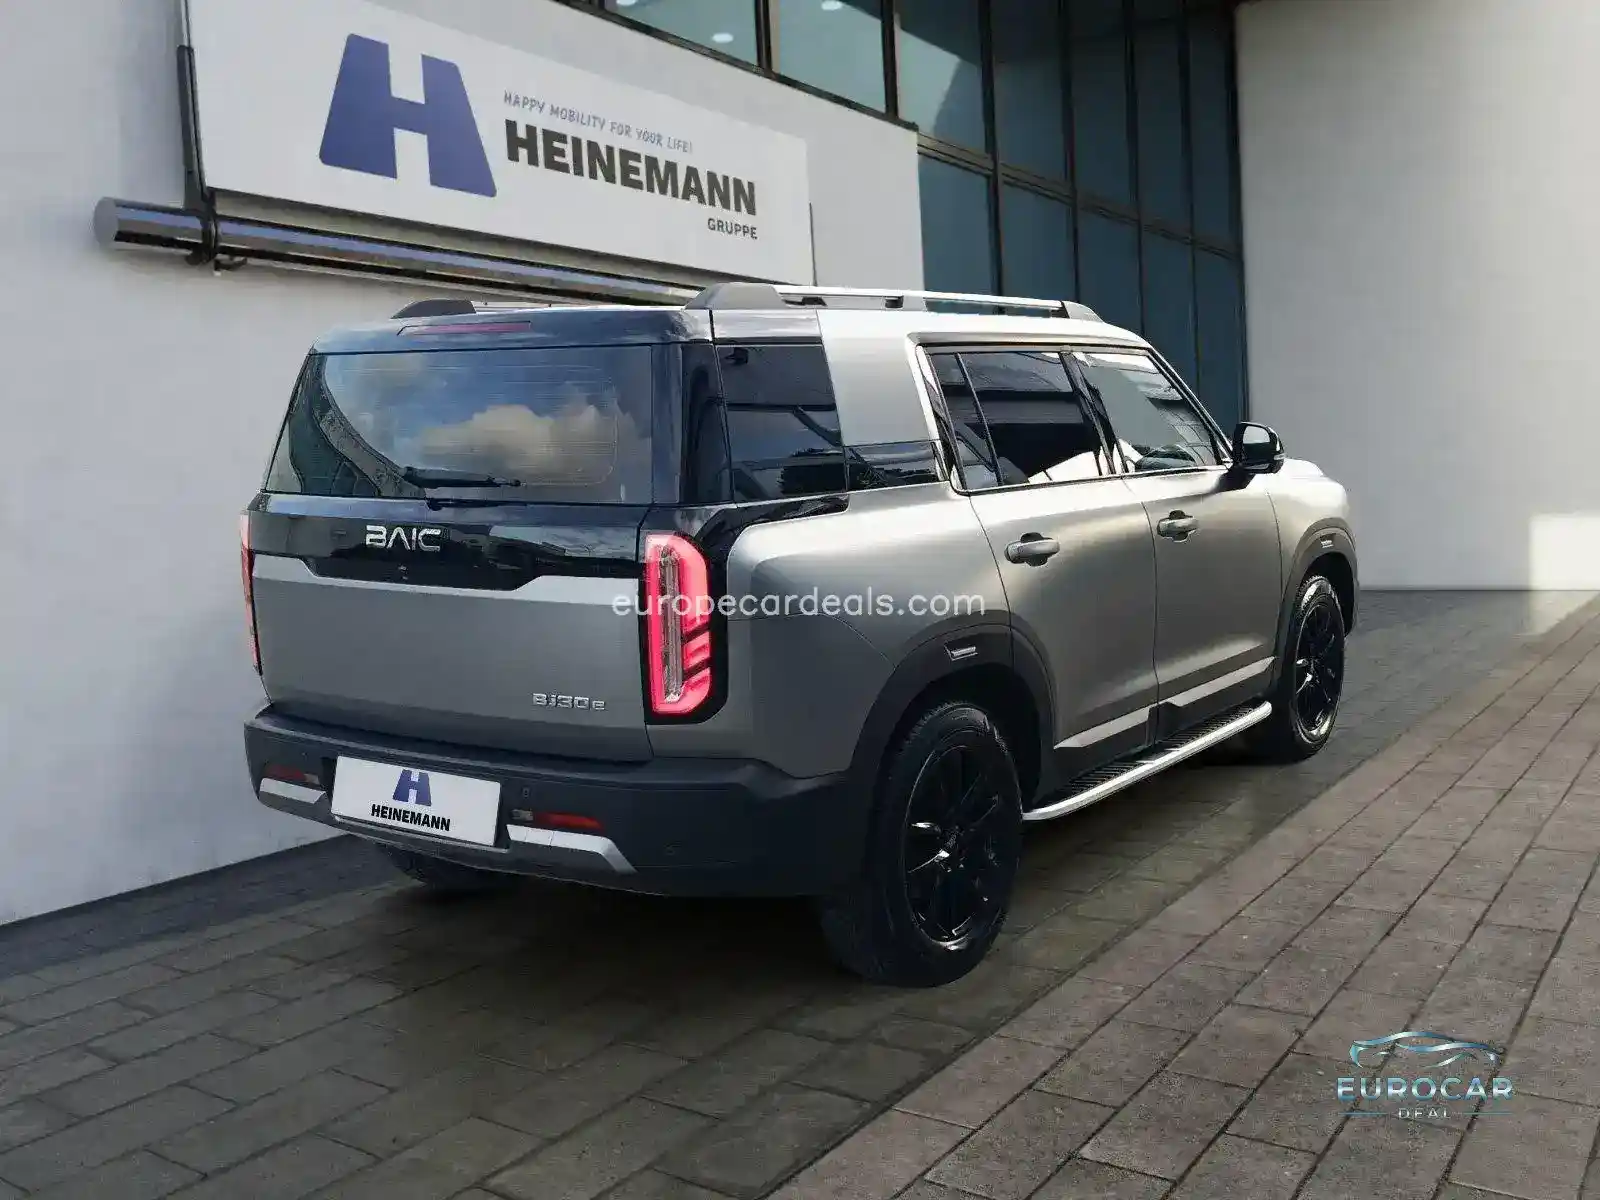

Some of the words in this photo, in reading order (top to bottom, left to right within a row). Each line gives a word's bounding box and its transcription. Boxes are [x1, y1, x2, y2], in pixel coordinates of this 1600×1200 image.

[503, 90, 545, 113] HAPPY
[549, 104, 605, 130] MOBILITY
[609, 121, 632, 136] FOR
[635, 127, 663, 148] YOUR
[667, 136, 692, 153] LIFE!
[505, 118, 757, 216] HEINEMANN
[707, 217, 758, 240] GRUPPE
[365, 524, 442, 552] BAIC
[370, 803, 451, 832] HEINEMANN
